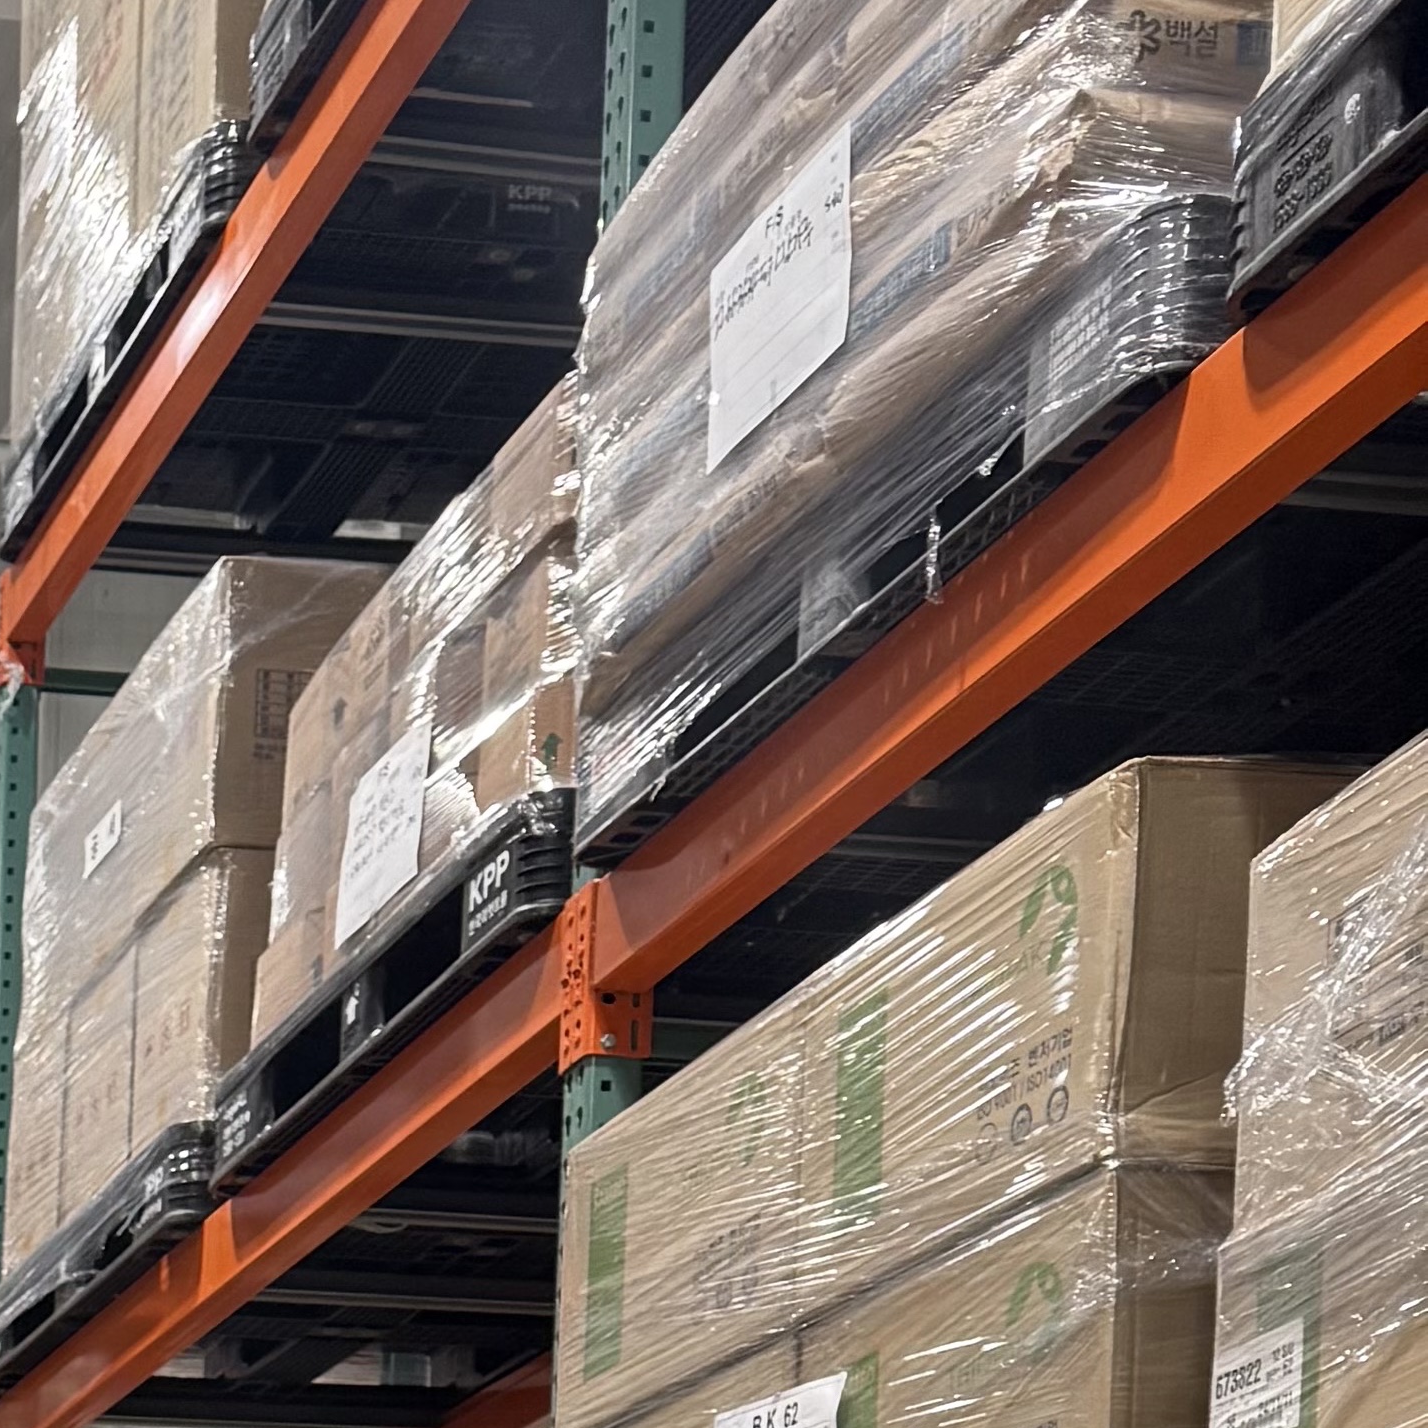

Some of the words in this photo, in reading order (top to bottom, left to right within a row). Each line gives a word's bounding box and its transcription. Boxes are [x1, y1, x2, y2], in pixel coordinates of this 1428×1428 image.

[1165, 20, 1219, 57] 백설
[468, 850, 510, 912] KPP
[784, 1402, 799, 1428] 62
